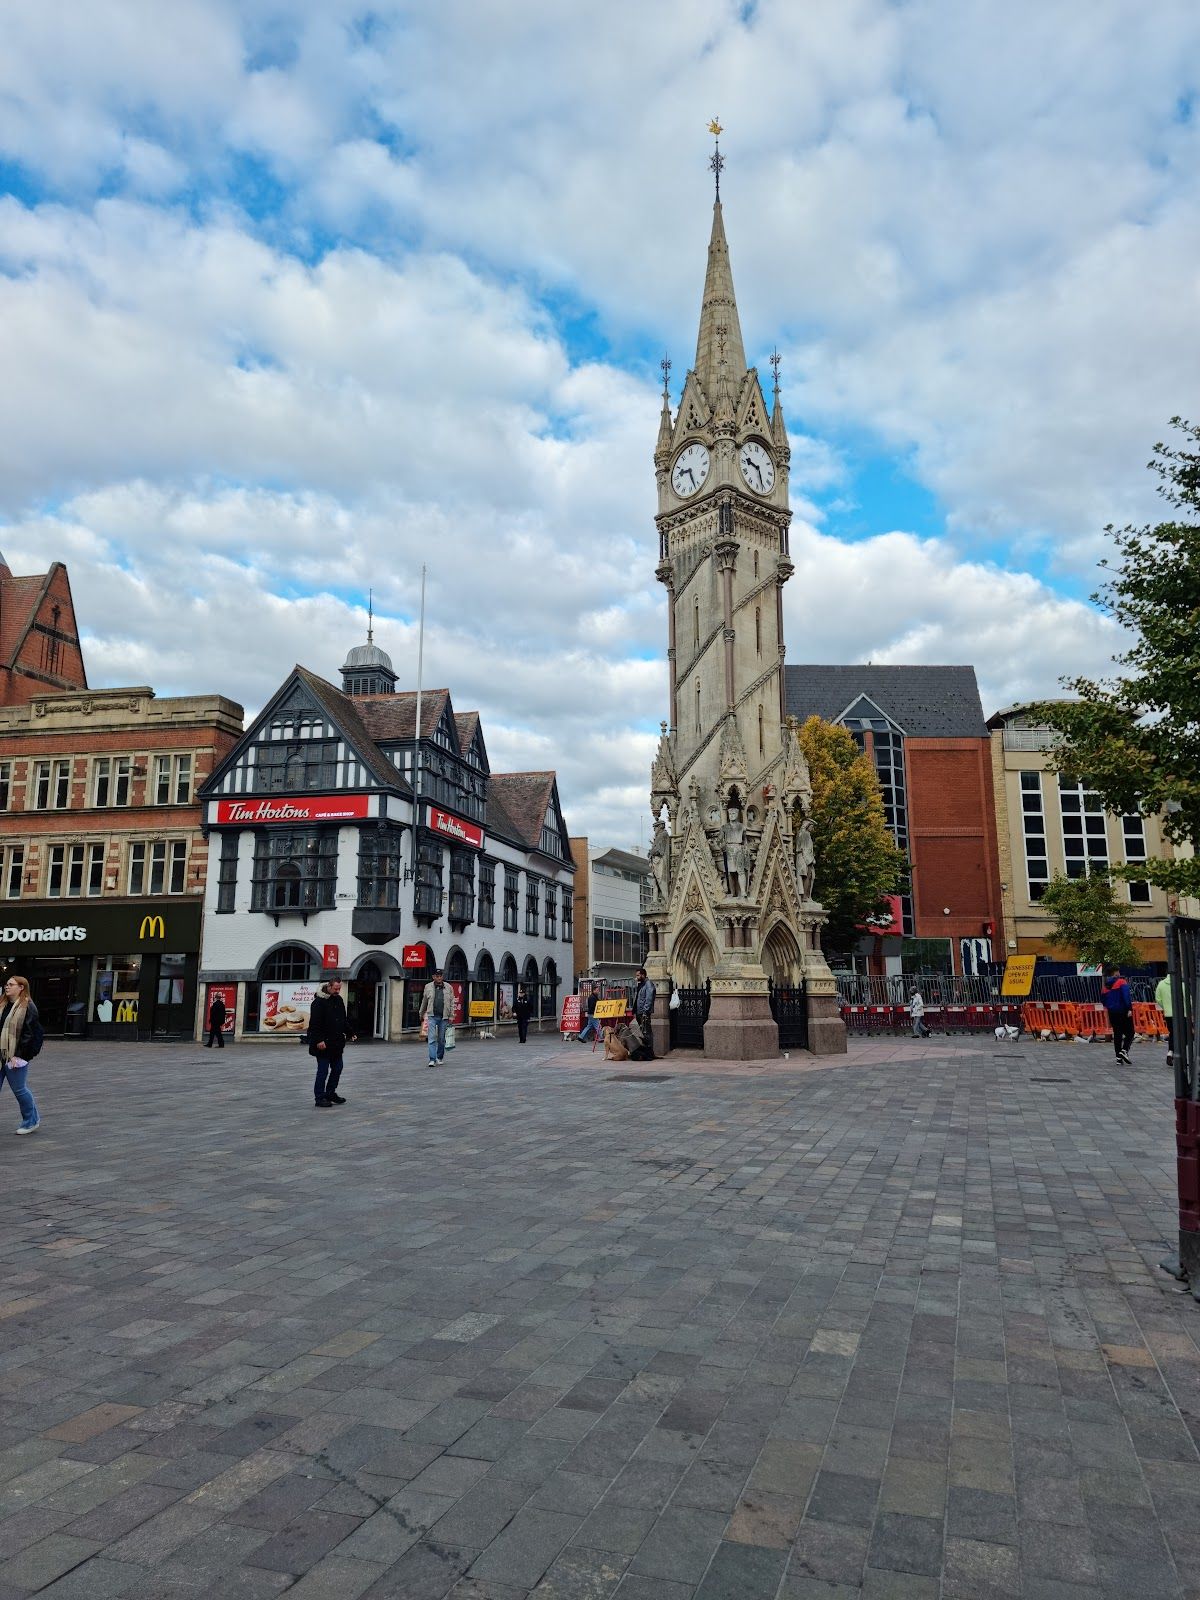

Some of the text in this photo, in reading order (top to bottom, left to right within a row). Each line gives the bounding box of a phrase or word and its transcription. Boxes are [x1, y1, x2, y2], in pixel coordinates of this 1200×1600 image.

[229, 801, 309, 820] Tim Hortons
[596, 1005, 613, 1013] EXIT
